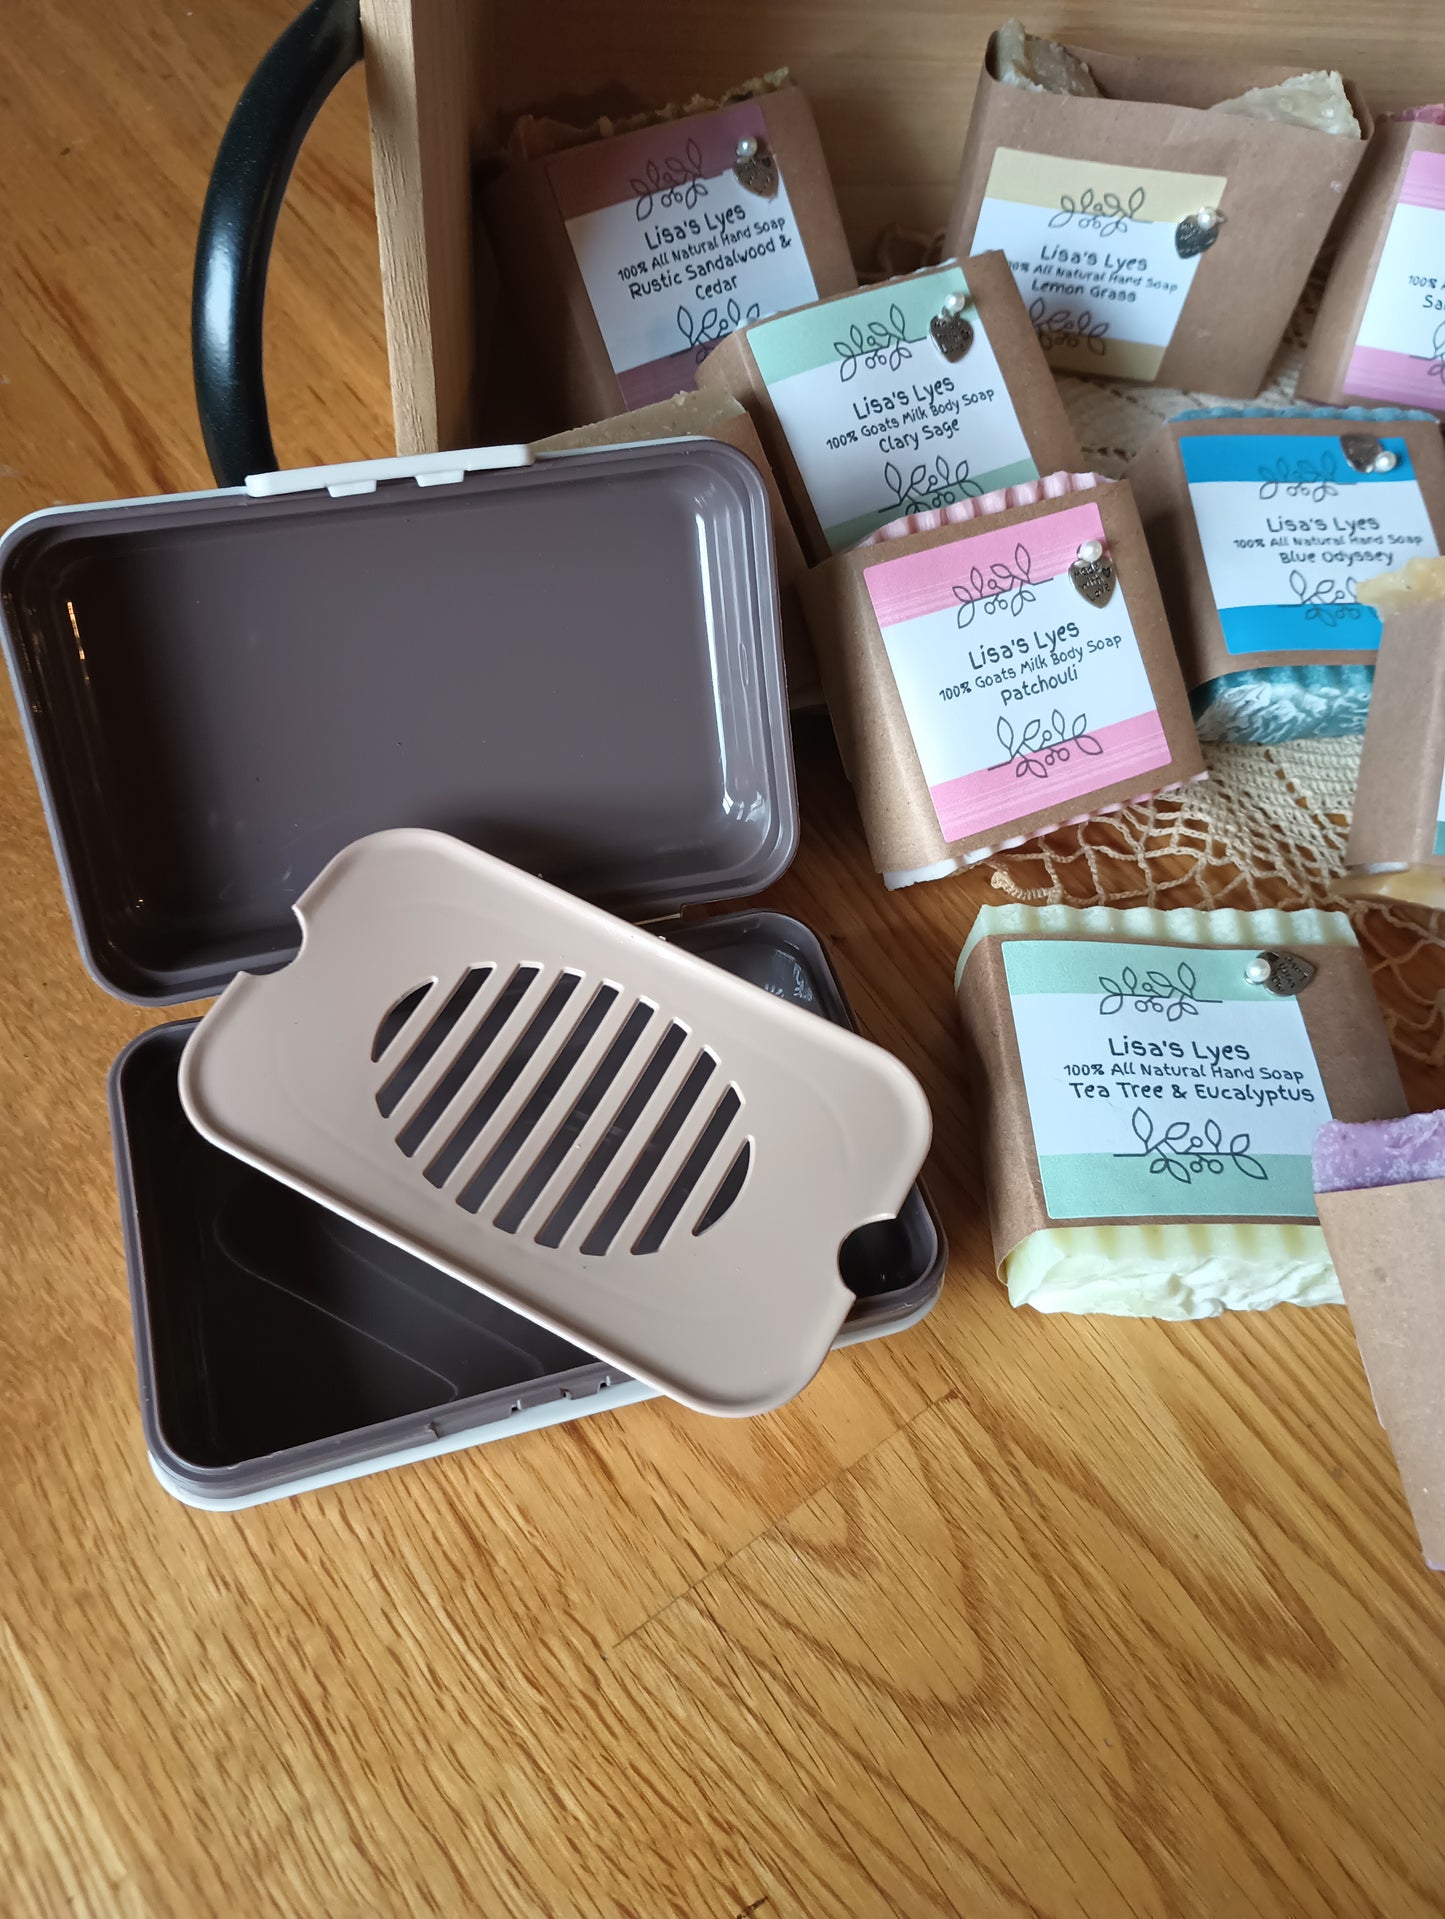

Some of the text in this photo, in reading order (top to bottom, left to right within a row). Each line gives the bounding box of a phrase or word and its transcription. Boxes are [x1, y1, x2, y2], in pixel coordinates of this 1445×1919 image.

[644, 205, 746, 251] Lisa's Lyes
[617, 217, 786, 281] 100% All Natural Hand Soap
[1040, 244, 1148, 274] Lisa's Lyes
[628, 235, 792, 300] Rustic Sandalwood &
[1033, 264, 1053, 275] All
[1055, 267, 1106, 281] Natural
[1108, 272, 1143, 286] Hand
[1145, 278, 1178, 294] Soap
[695, 275, 738, 300] Cedar
[1032, 279, 1136, 303] Lemon Grass
[1422, 294, 1445, 311] Sa
[852, 377, 955, 420] Lisa's Lyes
[826, 389, 995, 450] 100% Goats Milk Body Soap
[879, 418, 960, 453] Clary Sage
[1266, 515, 1380, 536] Lisa's Lyes
[1233, 534, 1424, 548] 100% All Natural Hand Soap
[1279, 550, 1393, 567] Blue Odyssey
[968, 622, 1080, 670] Lisa's Lyes
[938, 635, 1122, 701] 100% Goats Milk Body Soap
[1000, 664, 1078, 706] Patchouli
[1108, 1035, 1250, 1066] Lisa's Lyes
[1063, 1062, 1304, 1084] 100% All Natural Hand Soap
[1068, 1082, 1315, 1107] Tea Tree & Eucalyptus
